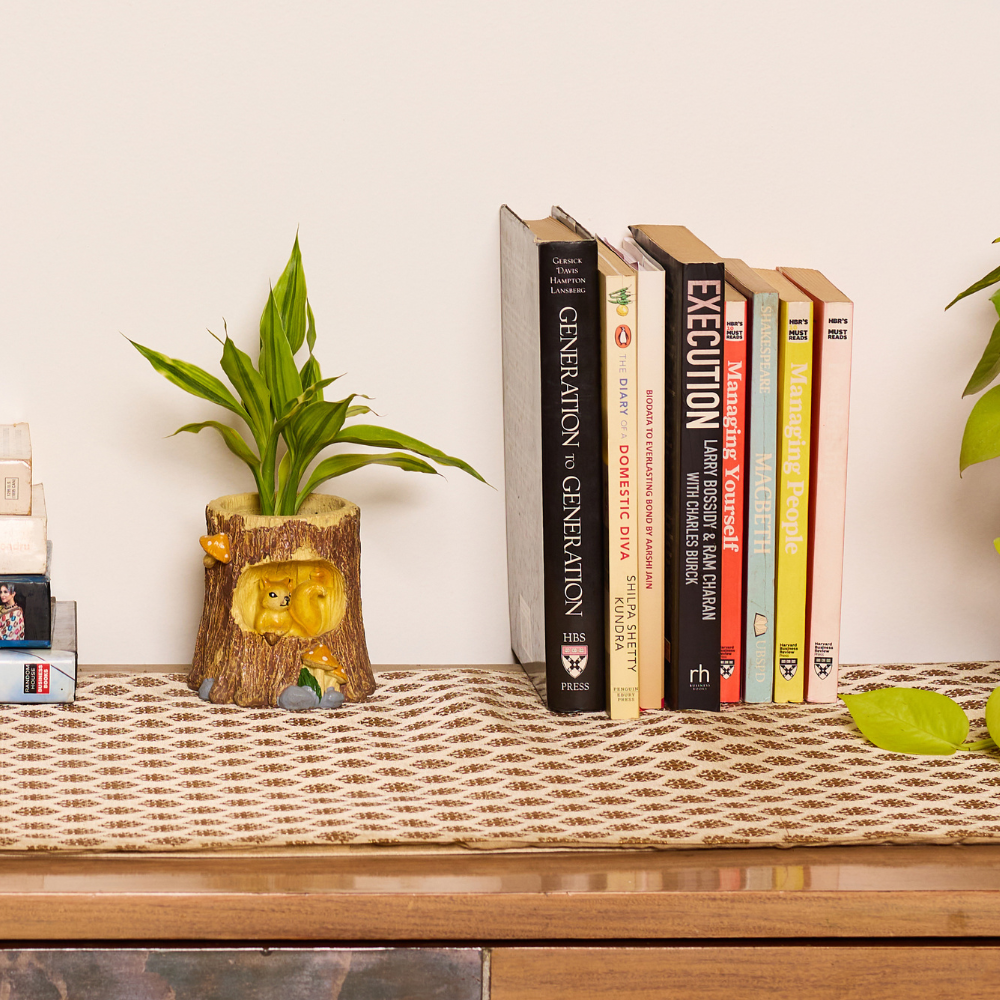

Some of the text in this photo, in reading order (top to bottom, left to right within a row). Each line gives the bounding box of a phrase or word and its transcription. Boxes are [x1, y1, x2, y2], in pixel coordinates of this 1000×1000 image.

[619, 354, 627, 373] THE
[686, 280, 721, 429] EXECUTION
[759, 306, 772, 394] SHAKESPEARE
[558, 306, 581, 448] GENERATION
[619, 378, 628, 416] DIARY
[620, 420, 628, 431] OF
[646, 428, 653, 439] TO
[645, 441, 653, 497] EVERLASTING
[722, 361, 743, 553] Managing Yourself
[781, 362, 808, 555] Managing People
[619, 445, 630, 520] DOMESTIC
[753, 453, 773, 554] MACBETH
[645, 499, 653, 524] BOND
[646, 526, 653, 536] BY
[685, 472, 700, 585] WITH CHARLES BURCK
[702, 439, 718, 621] LARRY BOSSIDY & RAM CHARAN
[562, 475, 583, 617] GENERATION
[620, 526, 630, 561] DIVA
[645, 538, 653, 569] AARSHI
[645, 571, 653, 590] JAIN
[563, 632, 586, 642] HBS
[614, 597, 624, 651] KUNDRA
[626, 575, 637, 673] SHILPA SHETTY
[690, 663, 710, 683] rh
[755, 640, 766, 682] UBSPD
[561, 682, 590, 691] PRESS
